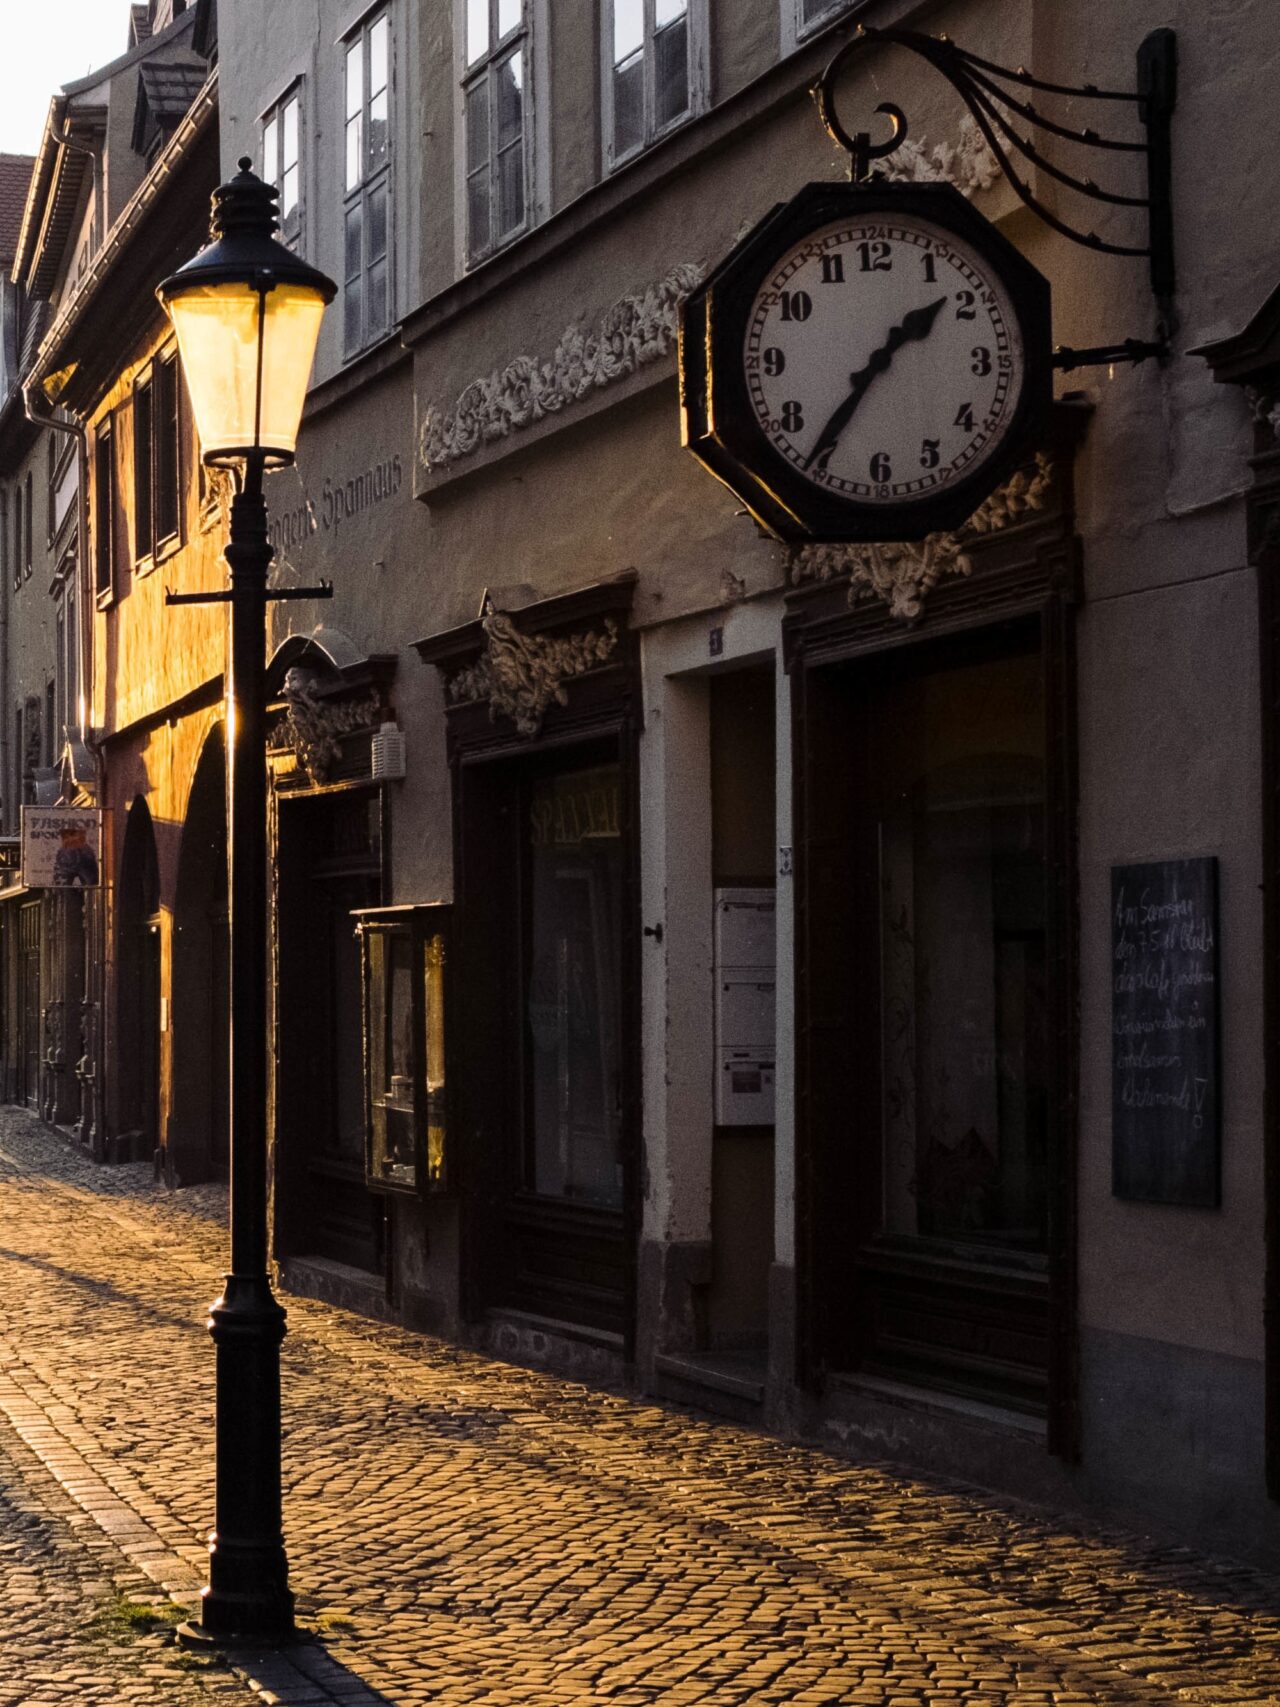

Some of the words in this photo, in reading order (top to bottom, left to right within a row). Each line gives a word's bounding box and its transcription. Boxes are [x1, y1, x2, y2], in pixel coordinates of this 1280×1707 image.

[867, 226, 886, 240] 24
[819, 254, 845, 284] 11
[856, 241, 891, 272] 12
[920, 253, 937, 283] 1
[780, 291, 812, 321] 10
[956, 291, 976, 320] 2
[764, 347, 785, 377] 9
[971, 347, 992, 376] 3
[762, 419, 780, 433] 20
[781, 401, 804, 433] 8
[953, 402, 977, 432] 4
[870, 452, 891, 483] 6
[920, 440, 940, 469] 5
[873, 485, 890, 498] 18
